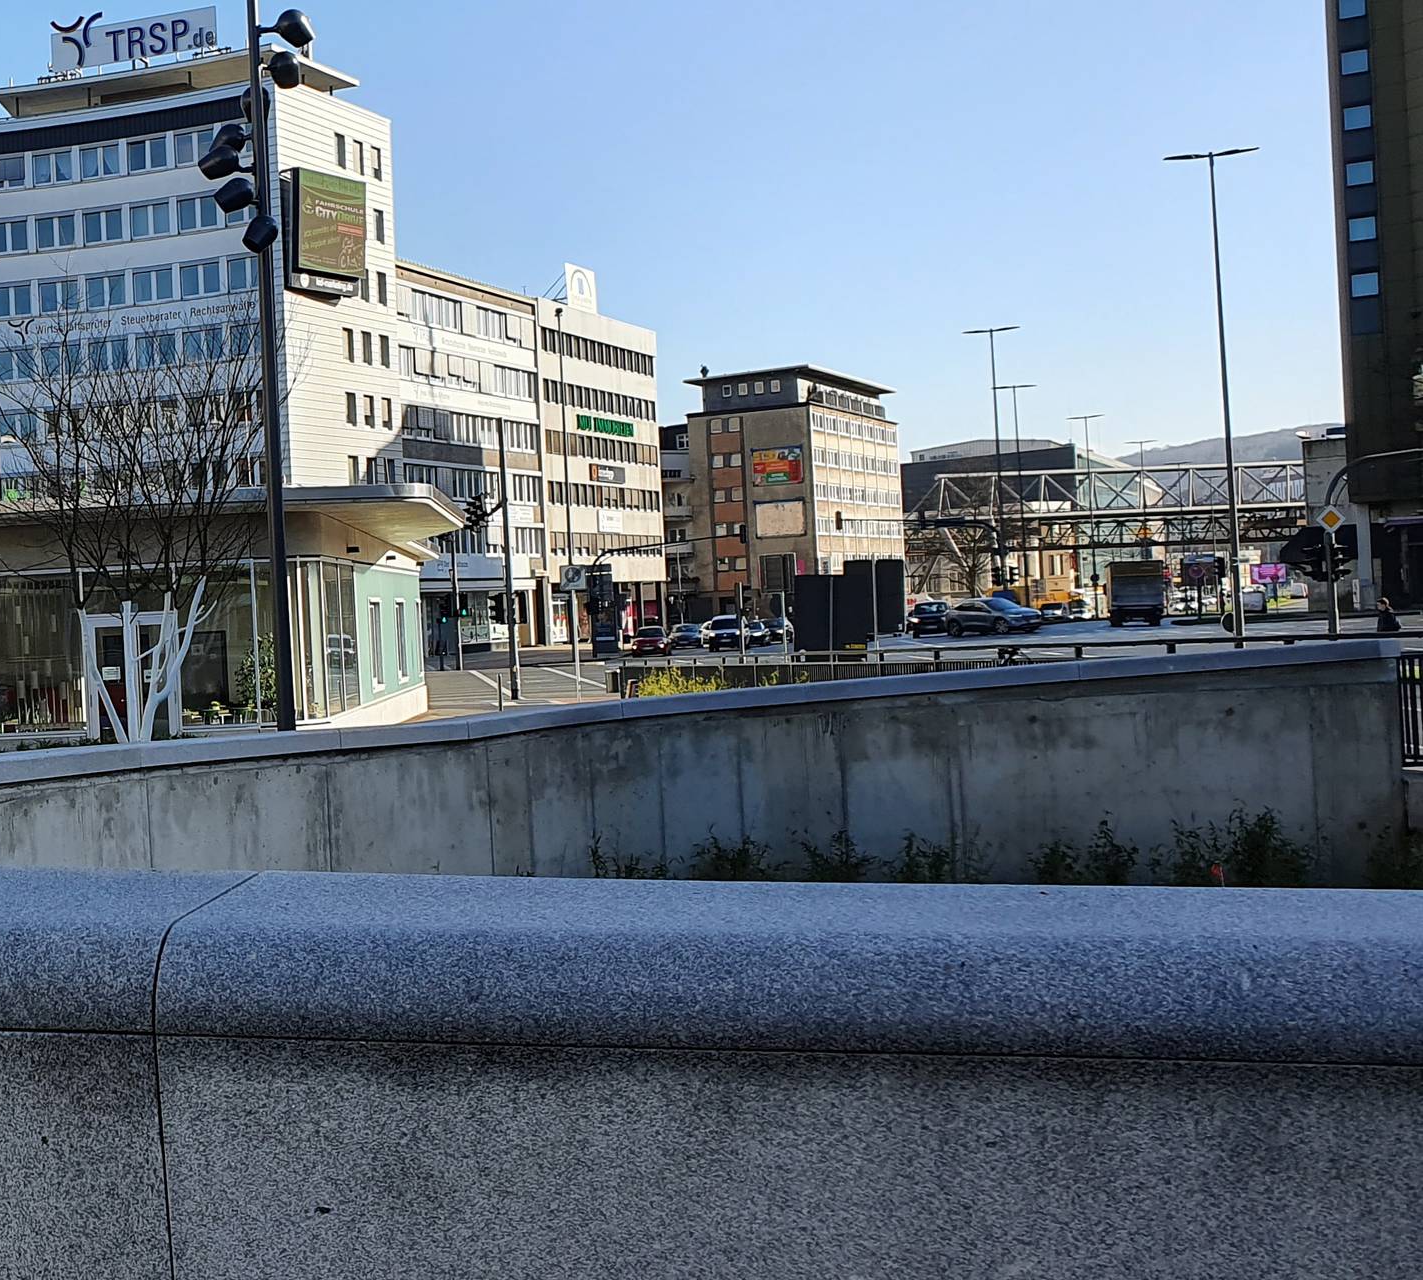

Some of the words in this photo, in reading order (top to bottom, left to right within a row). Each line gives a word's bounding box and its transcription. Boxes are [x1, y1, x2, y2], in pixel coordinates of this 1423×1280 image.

[105, 19, 216, 62] TRSP.de
[315, 199, 365, 215] FAHRSCHULE
[120, 310, 182, 326] Steuerberater
